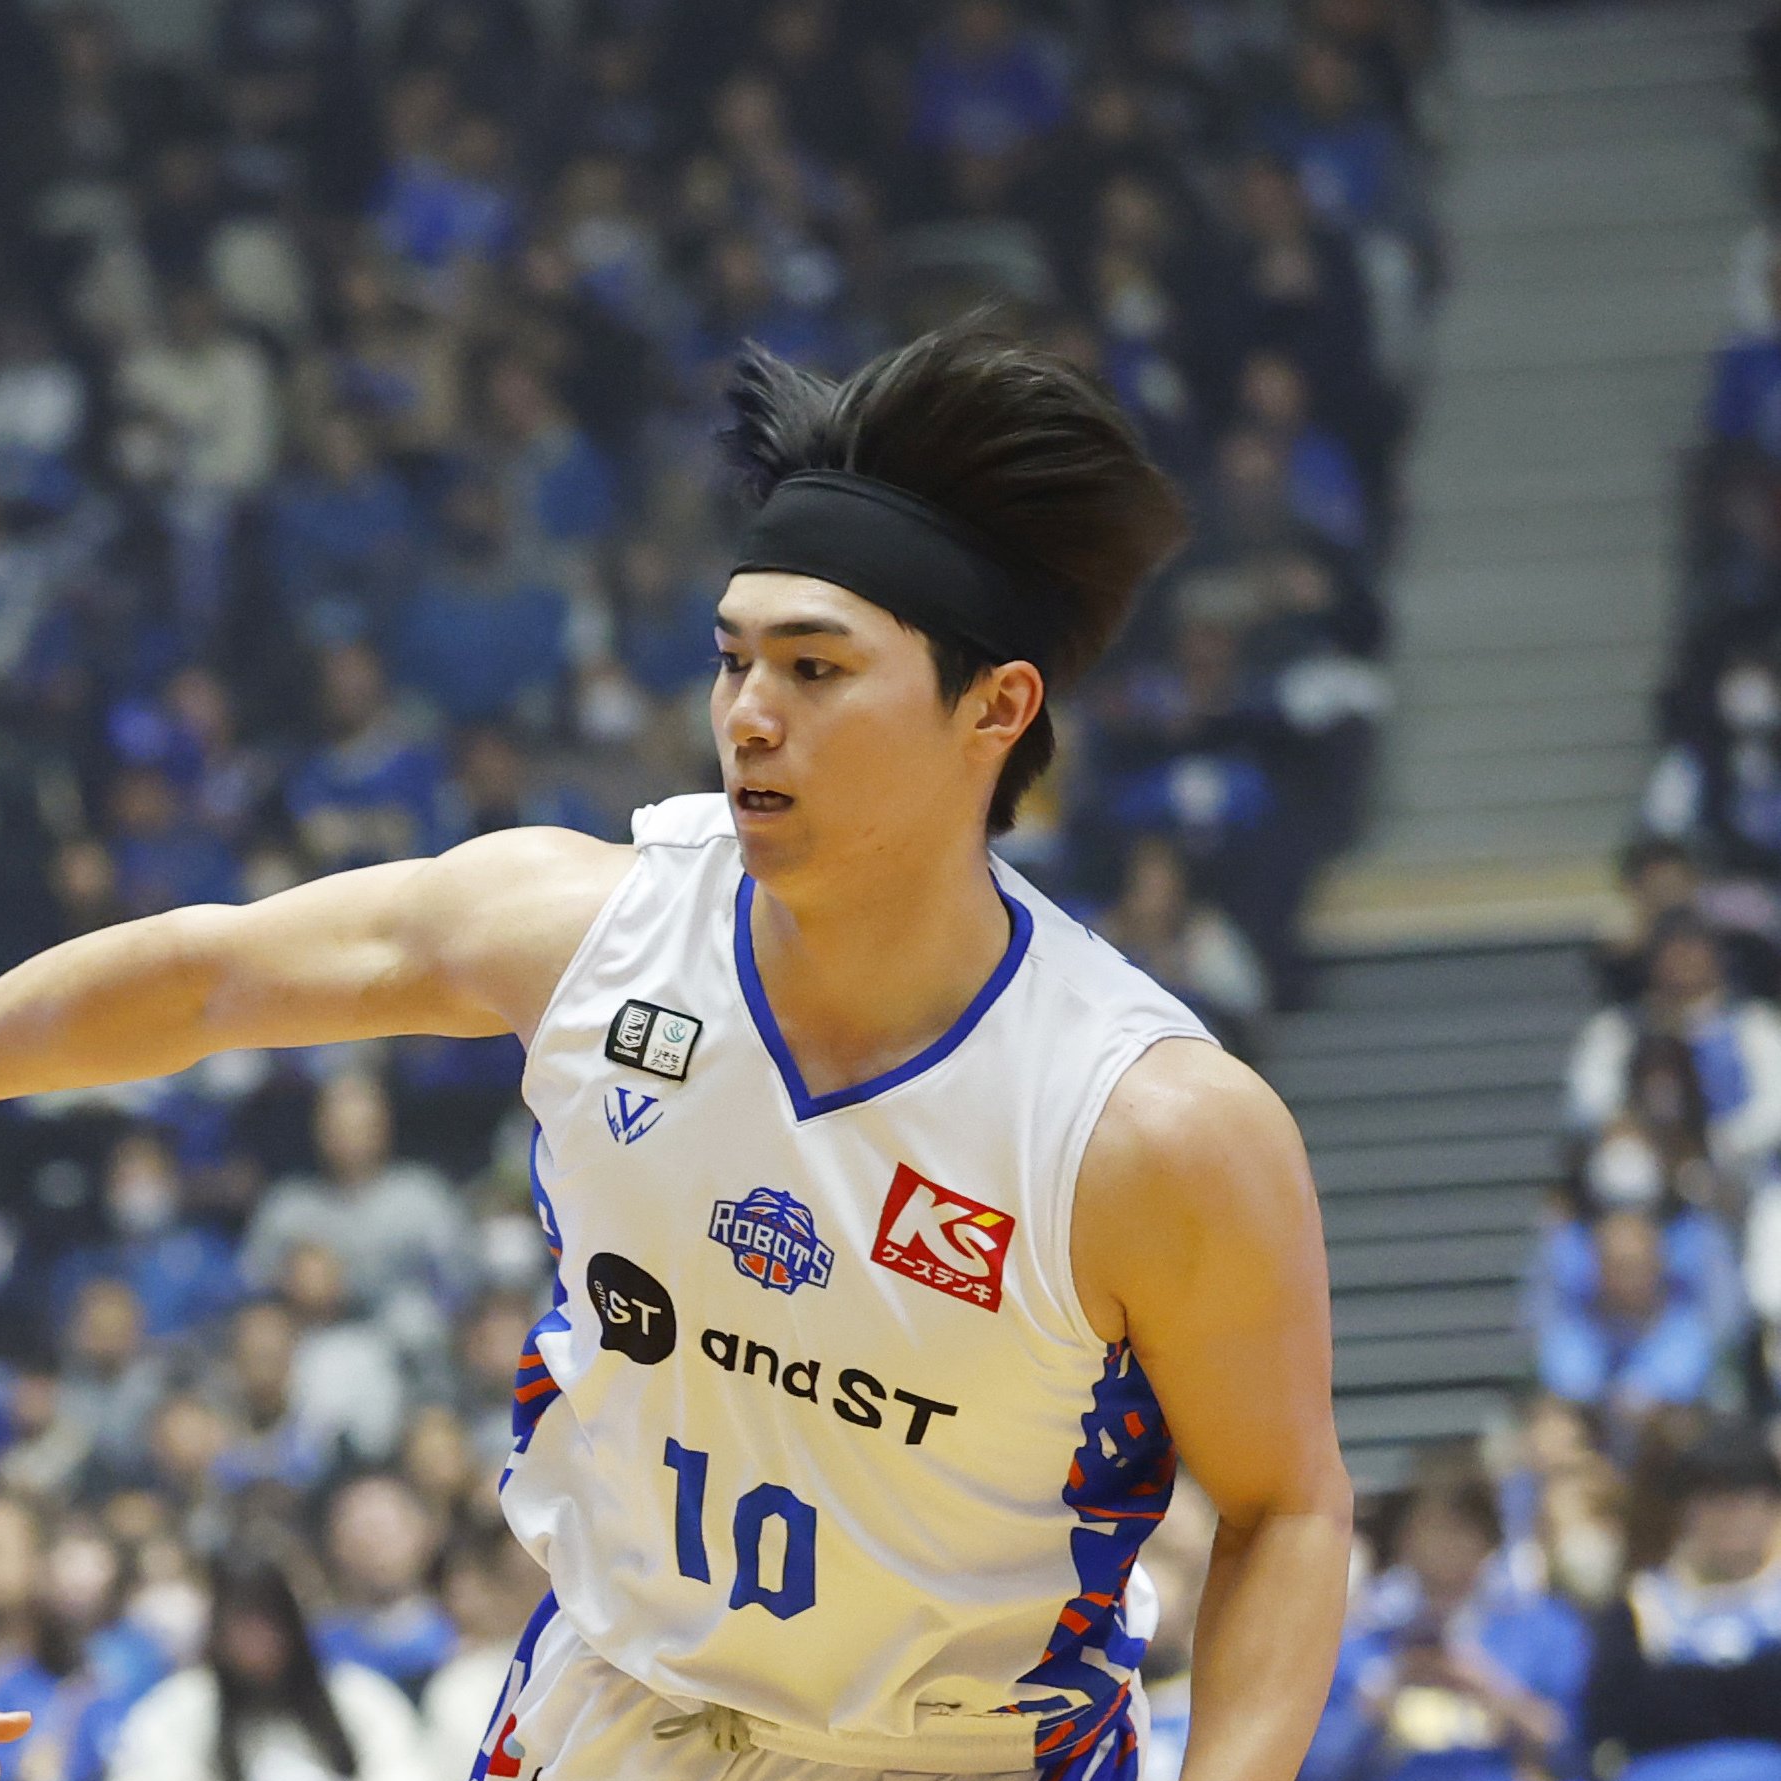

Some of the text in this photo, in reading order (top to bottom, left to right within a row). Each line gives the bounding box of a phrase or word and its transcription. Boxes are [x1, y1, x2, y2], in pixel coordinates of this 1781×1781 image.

[653, 1048, 680, 1064] りそな
[711, 1203, 833, 1286] ROBOTS
[882, 1244, 993, 1303] ケーズデンキ
[663, 1436, 817, 1621] 10
